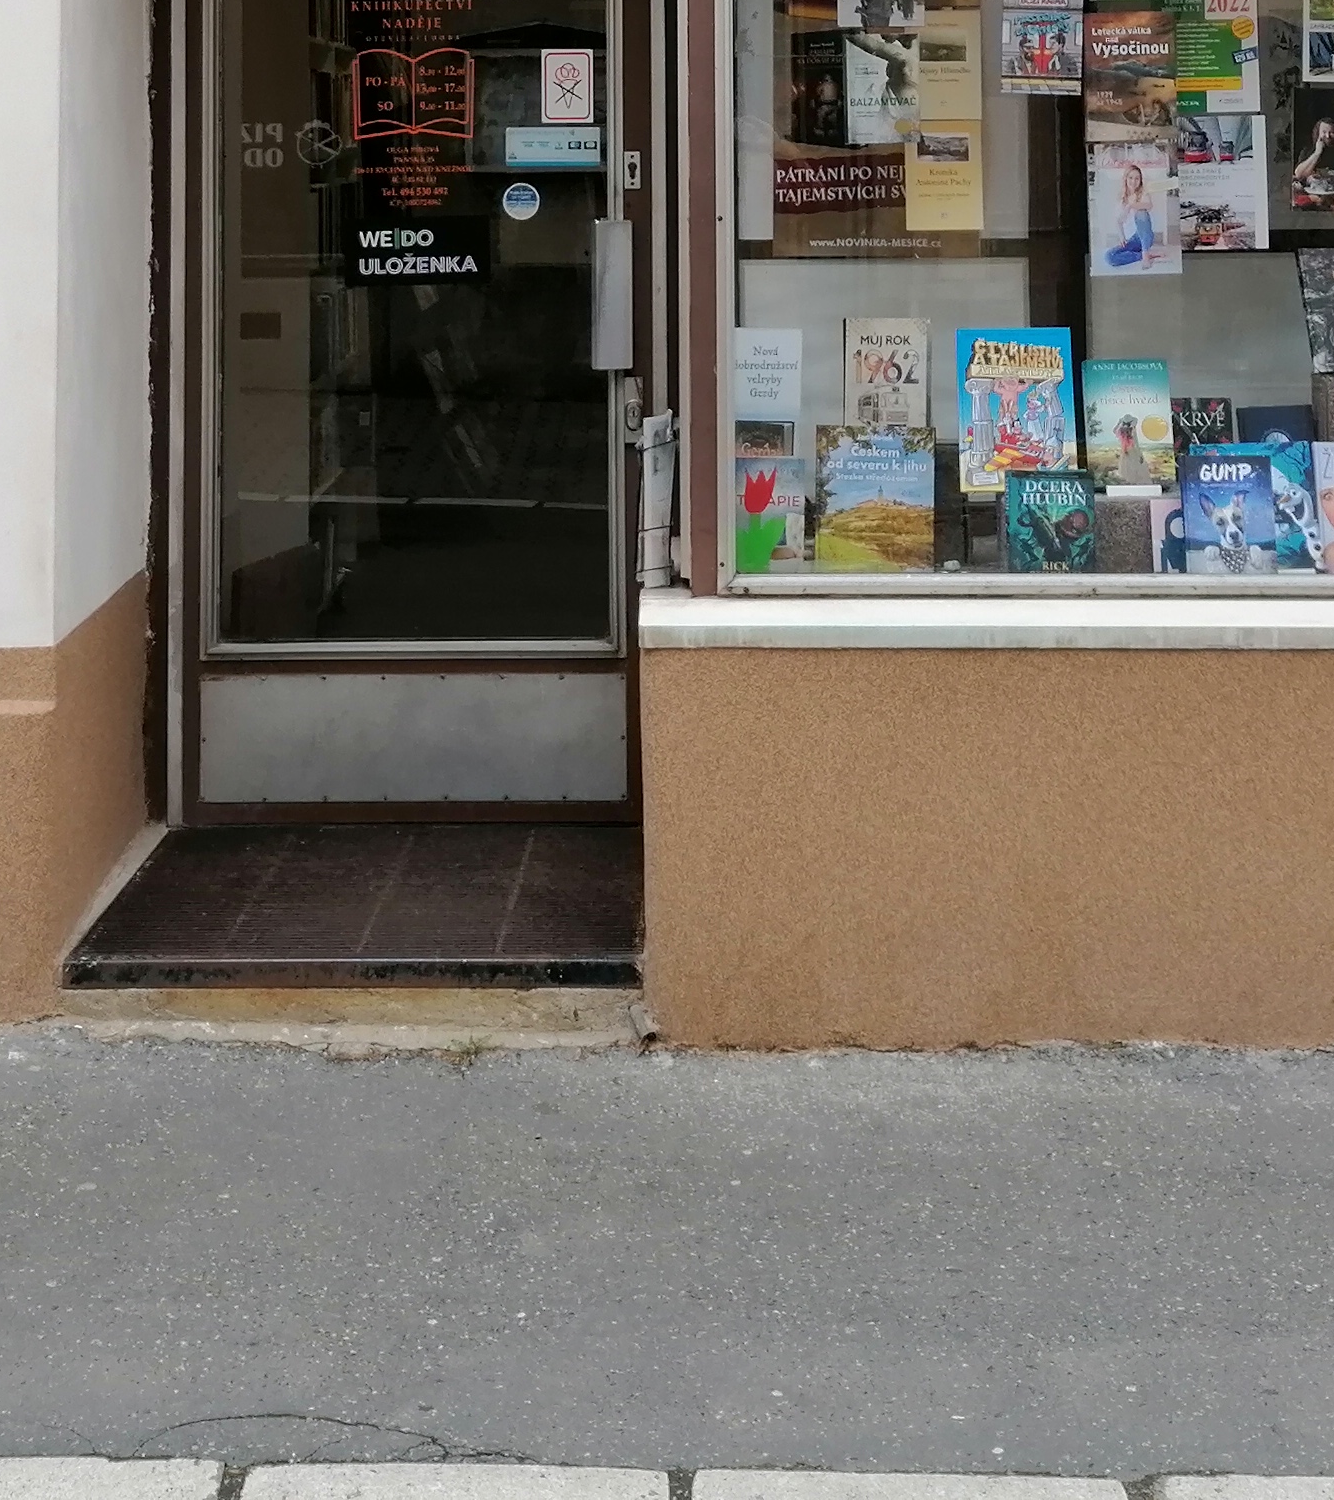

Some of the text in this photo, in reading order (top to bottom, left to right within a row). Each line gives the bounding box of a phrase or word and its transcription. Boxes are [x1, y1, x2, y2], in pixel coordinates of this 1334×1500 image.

[382, 15, 442, 31] NADĚJE
[1092, 26, 1152, 36] Letecká válka
[1092, 40, 1170, 59] Vysočinou
[776, 164, 905, 184] PÁTRÁNÍ PO NEJ
[776, 185, 886, 206] TAJEMSTVÍCH
[359, 253, 478, 275] ULOŽENKA
[885, 333, 911, 346] ROK
[753, 345, 779, 357] Nová
[853, 349, 920, 385] 1962
[746, 375, 783, 387] velryby
[851, 442, 900, 458] Českem
[826, 458, 927, 474] od severu k jihu
[1199, 463, 1251, 482] GUMP
[1024, 479, 1084, 494] DCERA
[736, 495, 800, 507] TAPIE
[1021, 491, 1088, 506] HLUBIN
